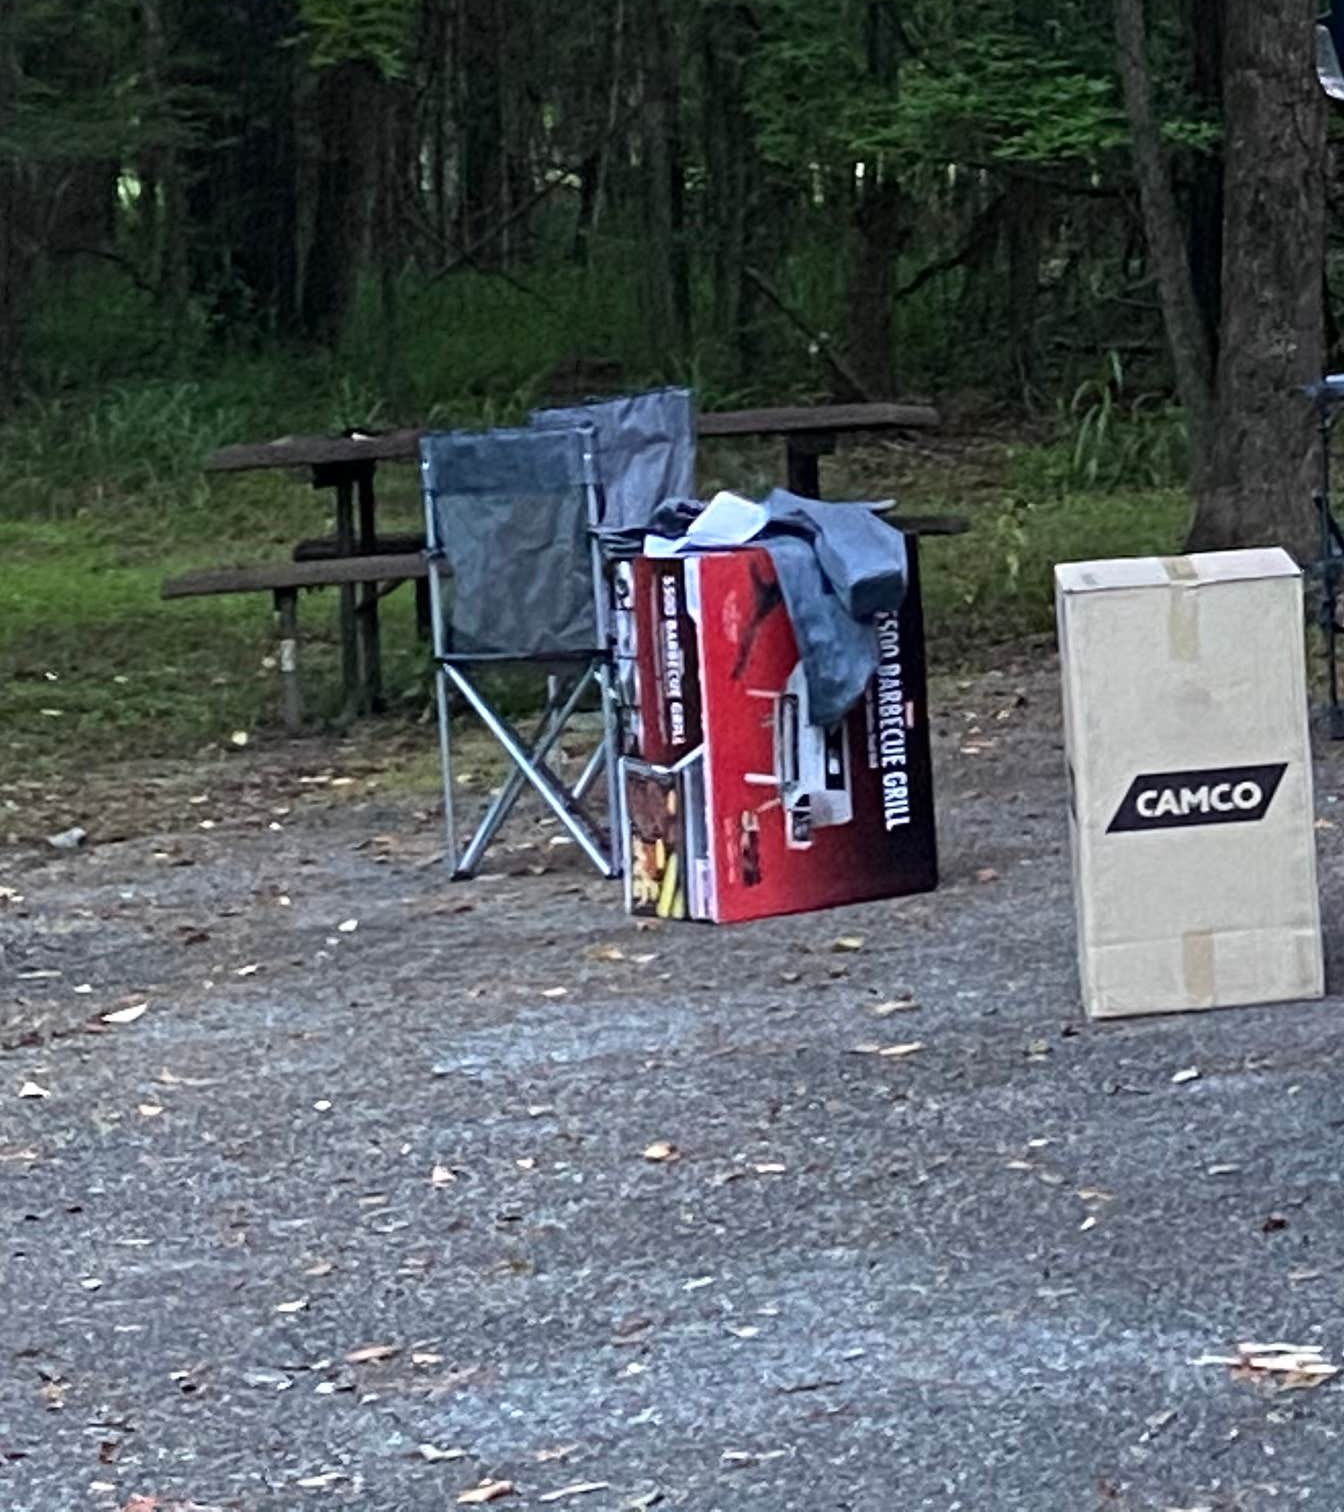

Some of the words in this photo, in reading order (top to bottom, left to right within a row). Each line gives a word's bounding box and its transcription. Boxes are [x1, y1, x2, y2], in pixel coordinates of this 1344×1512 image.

[877, 663, 906, 769] BARBECUE
[882, 771, 911, 832] GRILL
[1136, 780, 1263, 819] CAMCO
